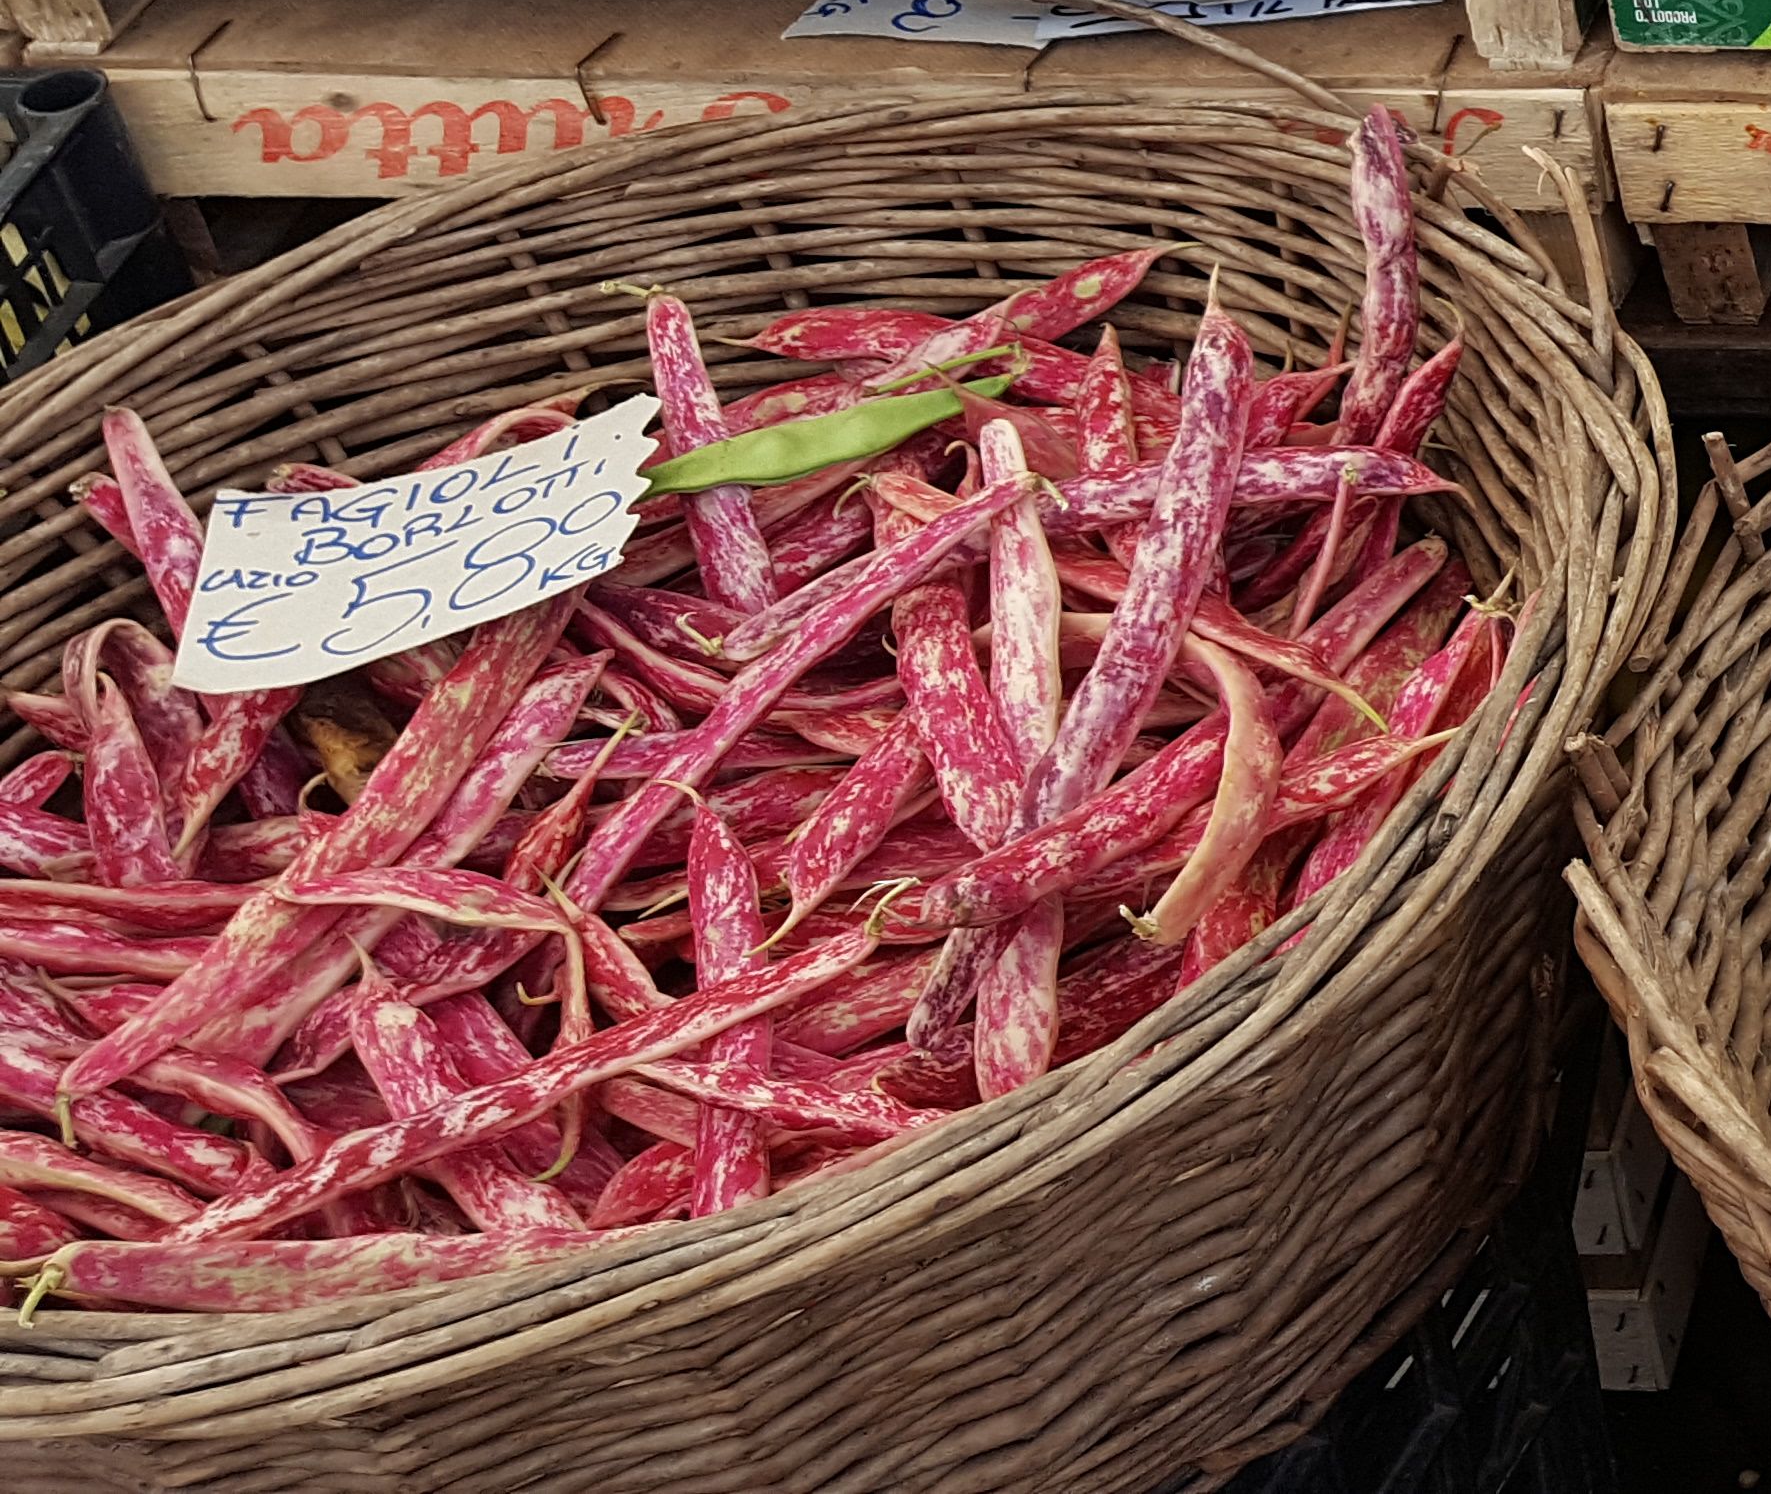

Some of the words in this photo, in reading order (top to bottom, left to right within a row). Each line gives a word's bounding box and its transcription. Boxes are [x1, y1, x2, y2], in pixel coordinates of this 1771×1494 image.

[214, 424, 582, 530] FAGIOLI
[293, 457, 607, 566] BORLOTTI
[197, 592, 302, 661] €
[320, 489, 624, 656] 5,80
[538, 542, 618, 590] KG
